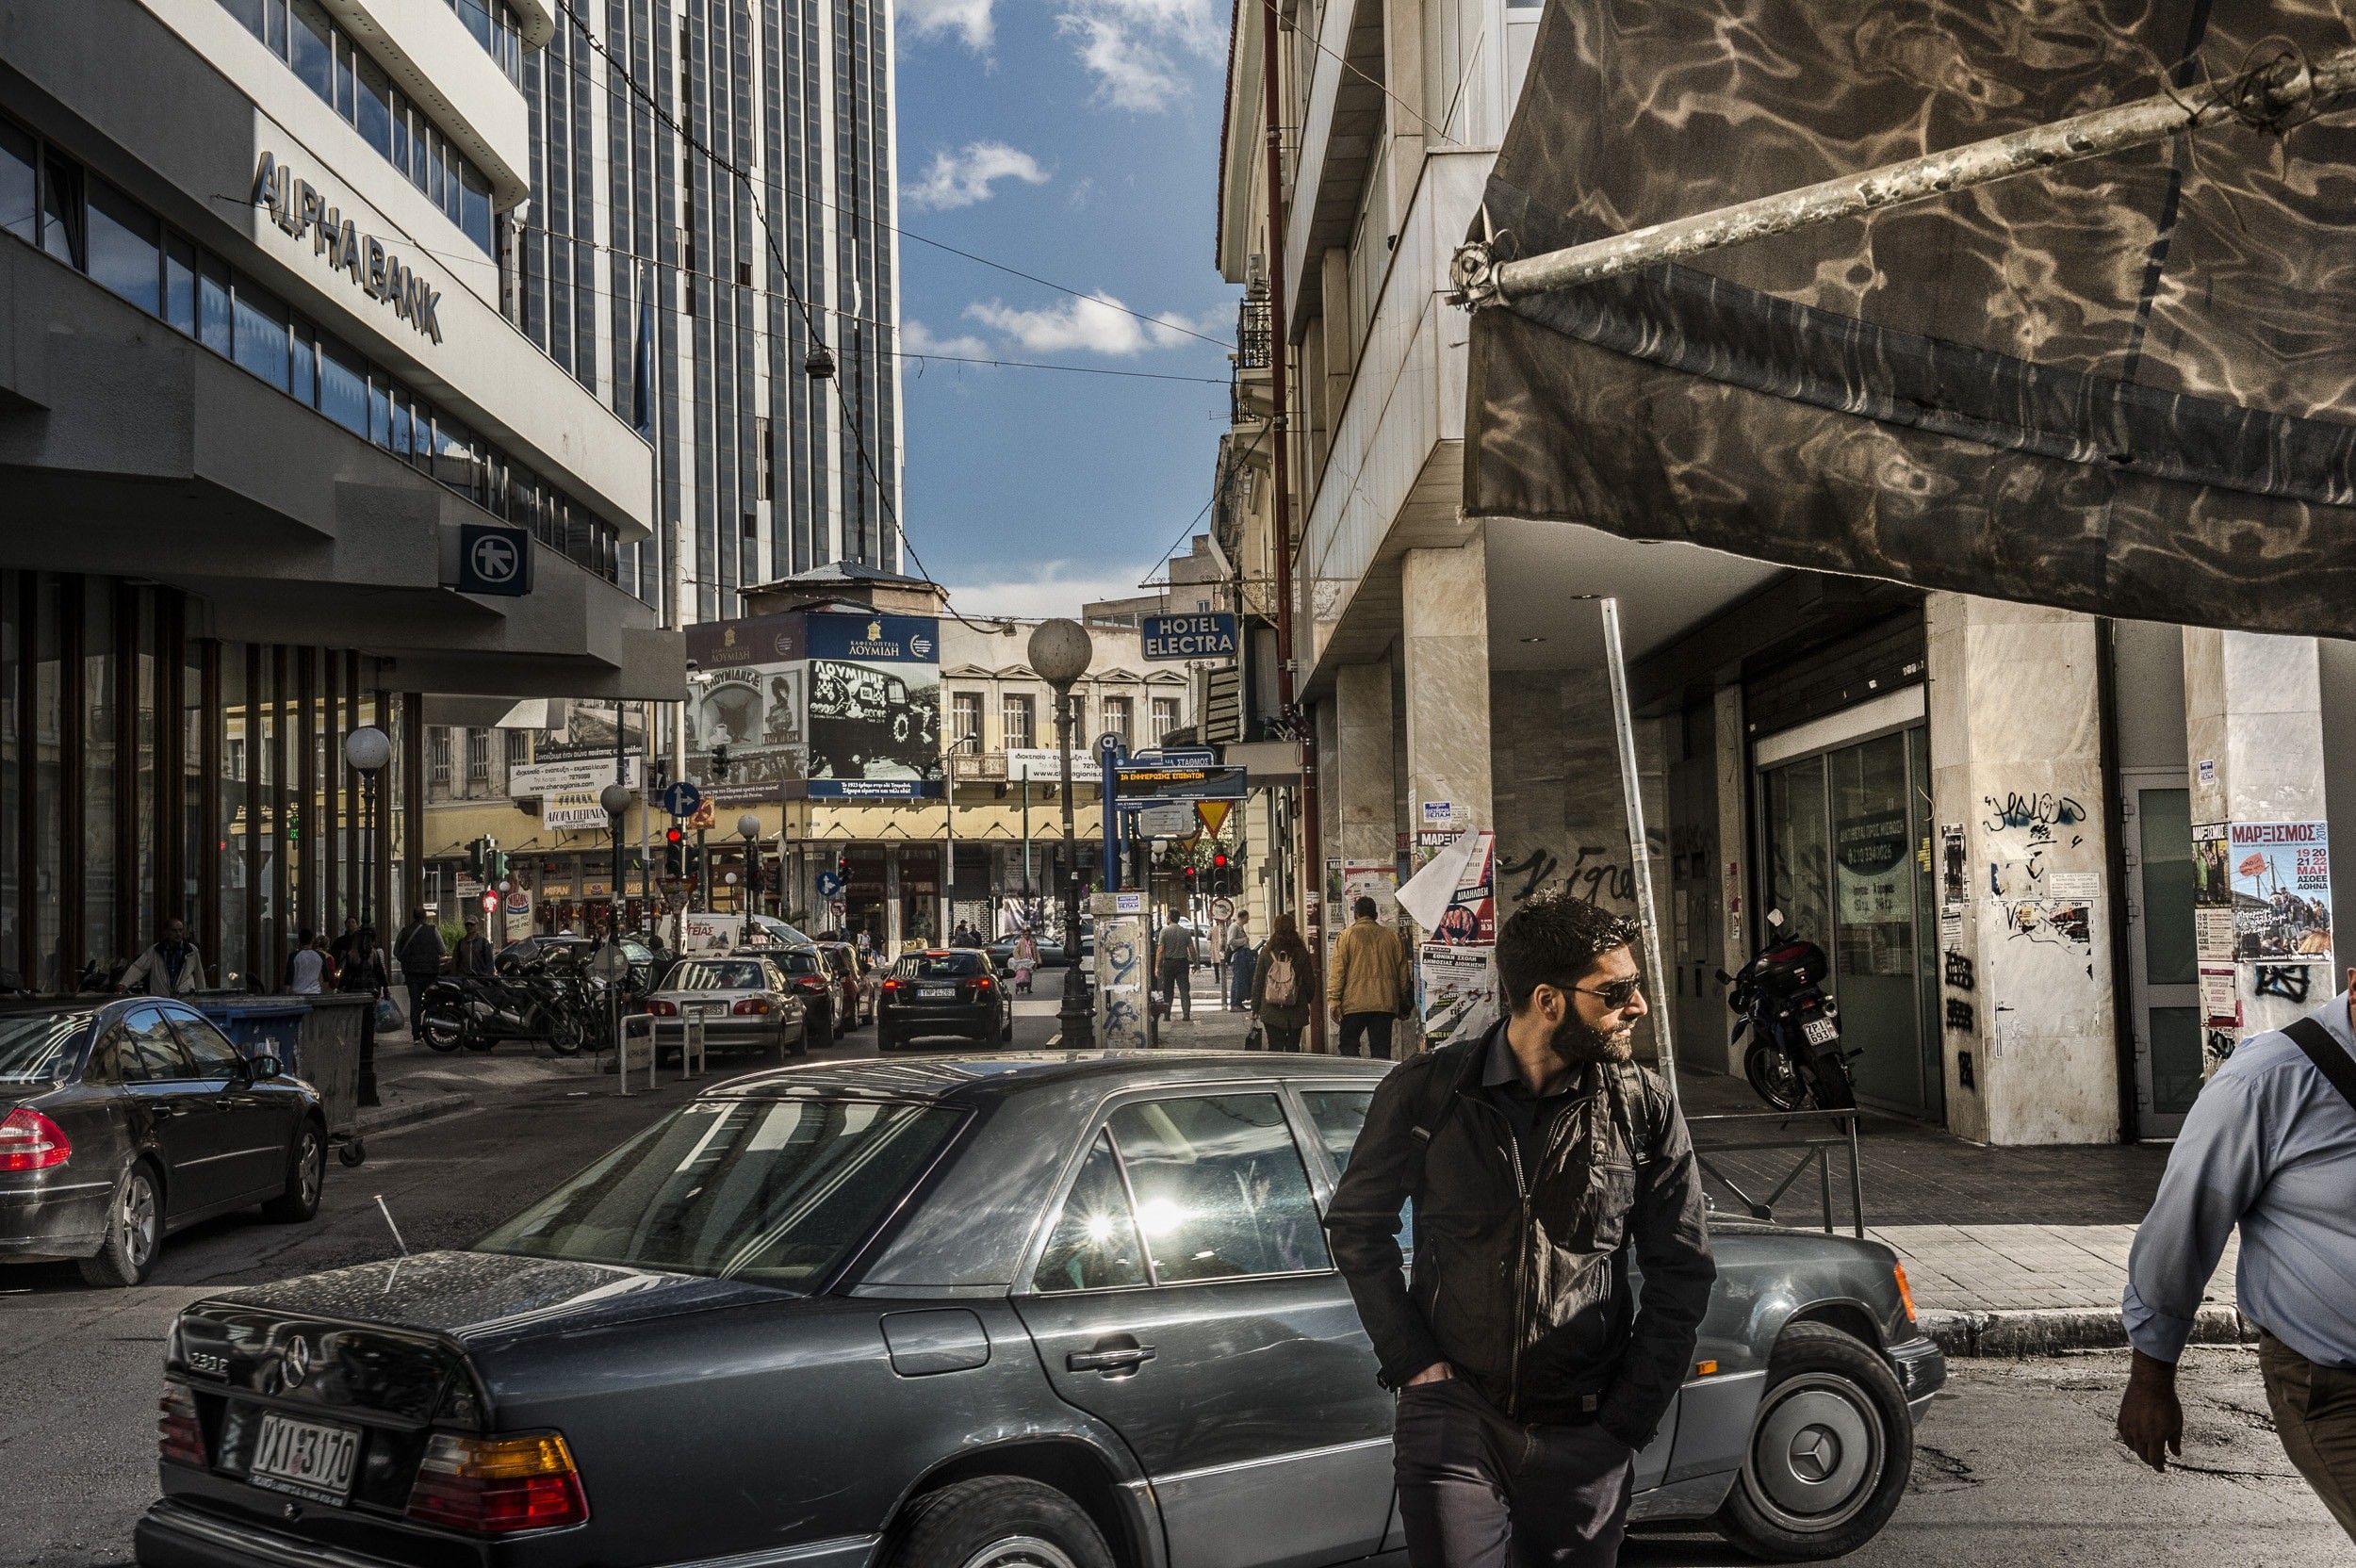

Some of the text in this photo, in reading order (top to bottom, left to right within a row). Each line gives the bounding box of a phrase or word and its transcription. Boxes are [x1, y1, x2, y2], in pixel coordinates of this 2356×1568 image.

[251, 151, 443, 347] ALPHA BANK
[1159, 617, 1219, 635] HOTEL
[849, 646, 899, 656] ΛΟΥΜΙΔΗ
[1146, 634, 1235, 656] ELECTRA
[712, 650, 750, 663] ΛΟΥΜΙΔΗ
[2233, 824, 2327, 842] ΜΑΡΞΙΣΜΟΣ 2016
[2313, 848, 2326, 857] 20
[2298, 866, 2328, 874] ΜΑΗ
[1457, 887, 1489, 901] ΔΙΑΔΗΛΩΣΗ
[1810, 1030, 1829, 1042] 693
